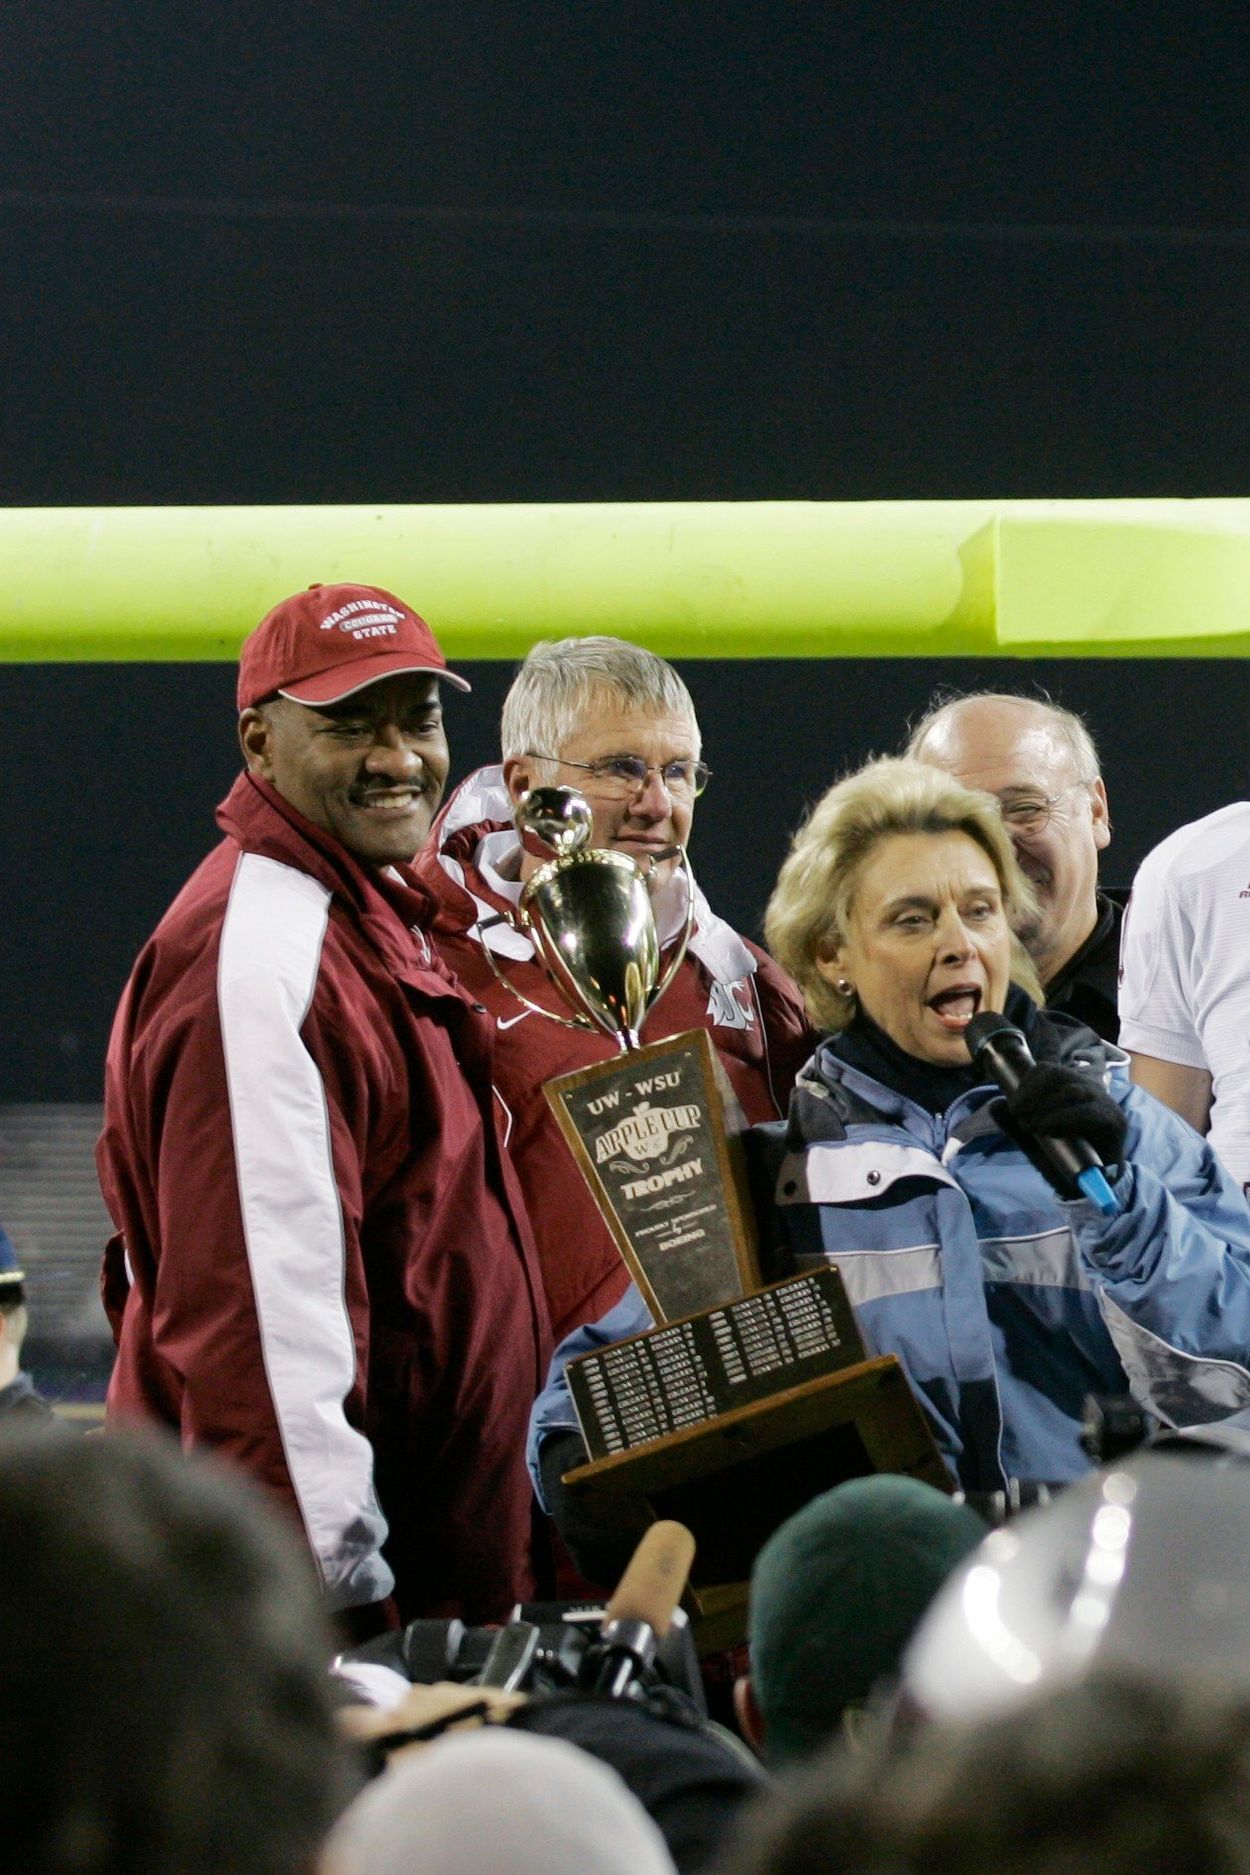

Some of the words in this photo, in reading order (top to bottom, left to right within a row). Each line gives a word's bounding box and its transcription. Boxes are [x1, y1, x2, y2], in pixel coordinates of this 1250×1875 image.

[320, 600, 406, 630] WASHINGTON
[352, 624, 397, 640] STATE
[587, 1090, 620, 1115] UW
[634, 1071, 681, 1096] WSU
[595, 1113, 660, 1164] APPLE
[659, 1104, 702, 1132] CUP
[620, 1157, 704, 1200] TROPHY
